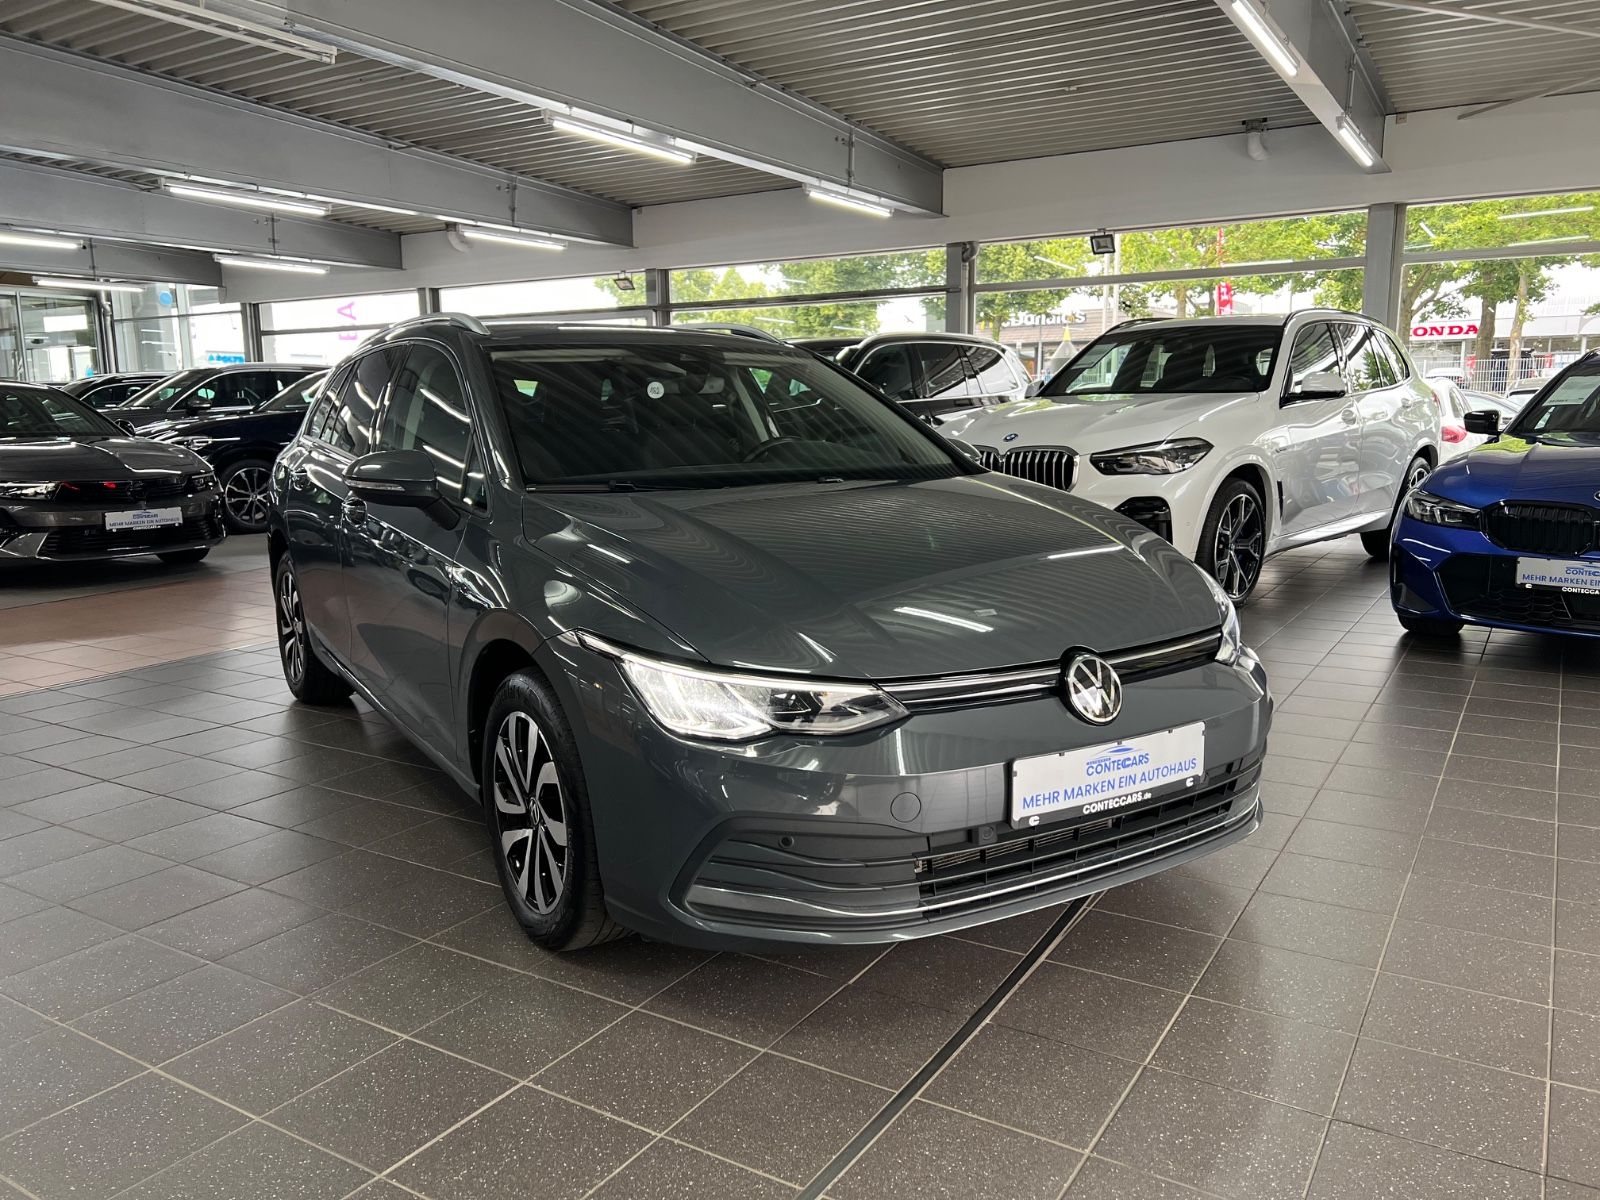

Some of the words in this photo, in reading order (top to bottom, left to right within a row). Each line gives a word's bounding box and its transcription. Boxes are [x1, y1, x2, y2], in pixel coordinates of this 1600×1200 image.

[1411, 325, 1479, 337] ONDA
[1522, 574, 1547, 582] MEHR
[1549, 576, 1588, 586] MARKEN
[1022, 790, 1060, 810] MEHR
[1063, 779, 1115, 801] MARKEN
[1119, 773, 1137, 789] EIN
[1139, 758, 1197, 783] AUTOHAUS
[1082, 791, 1152, 814] CONTECCARS.de
